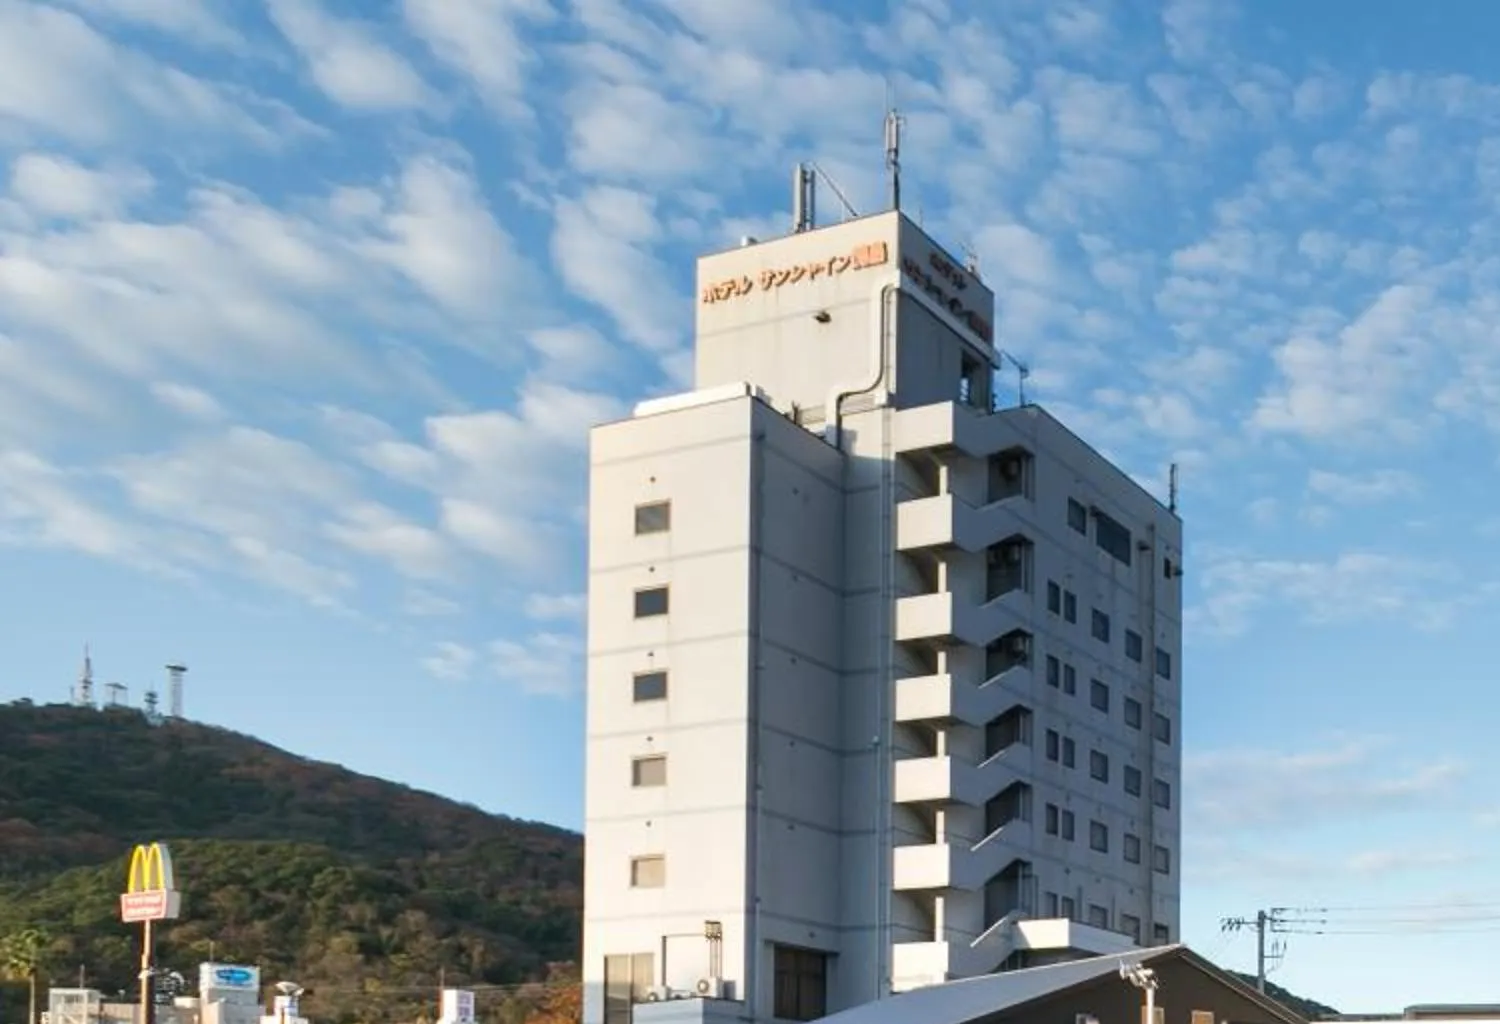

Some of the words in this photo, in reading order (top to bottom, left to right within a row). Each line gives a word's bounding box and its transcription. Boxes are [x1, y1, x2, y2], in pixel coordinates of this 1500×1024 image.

[760, 241, 889, 291] サンシャイン
